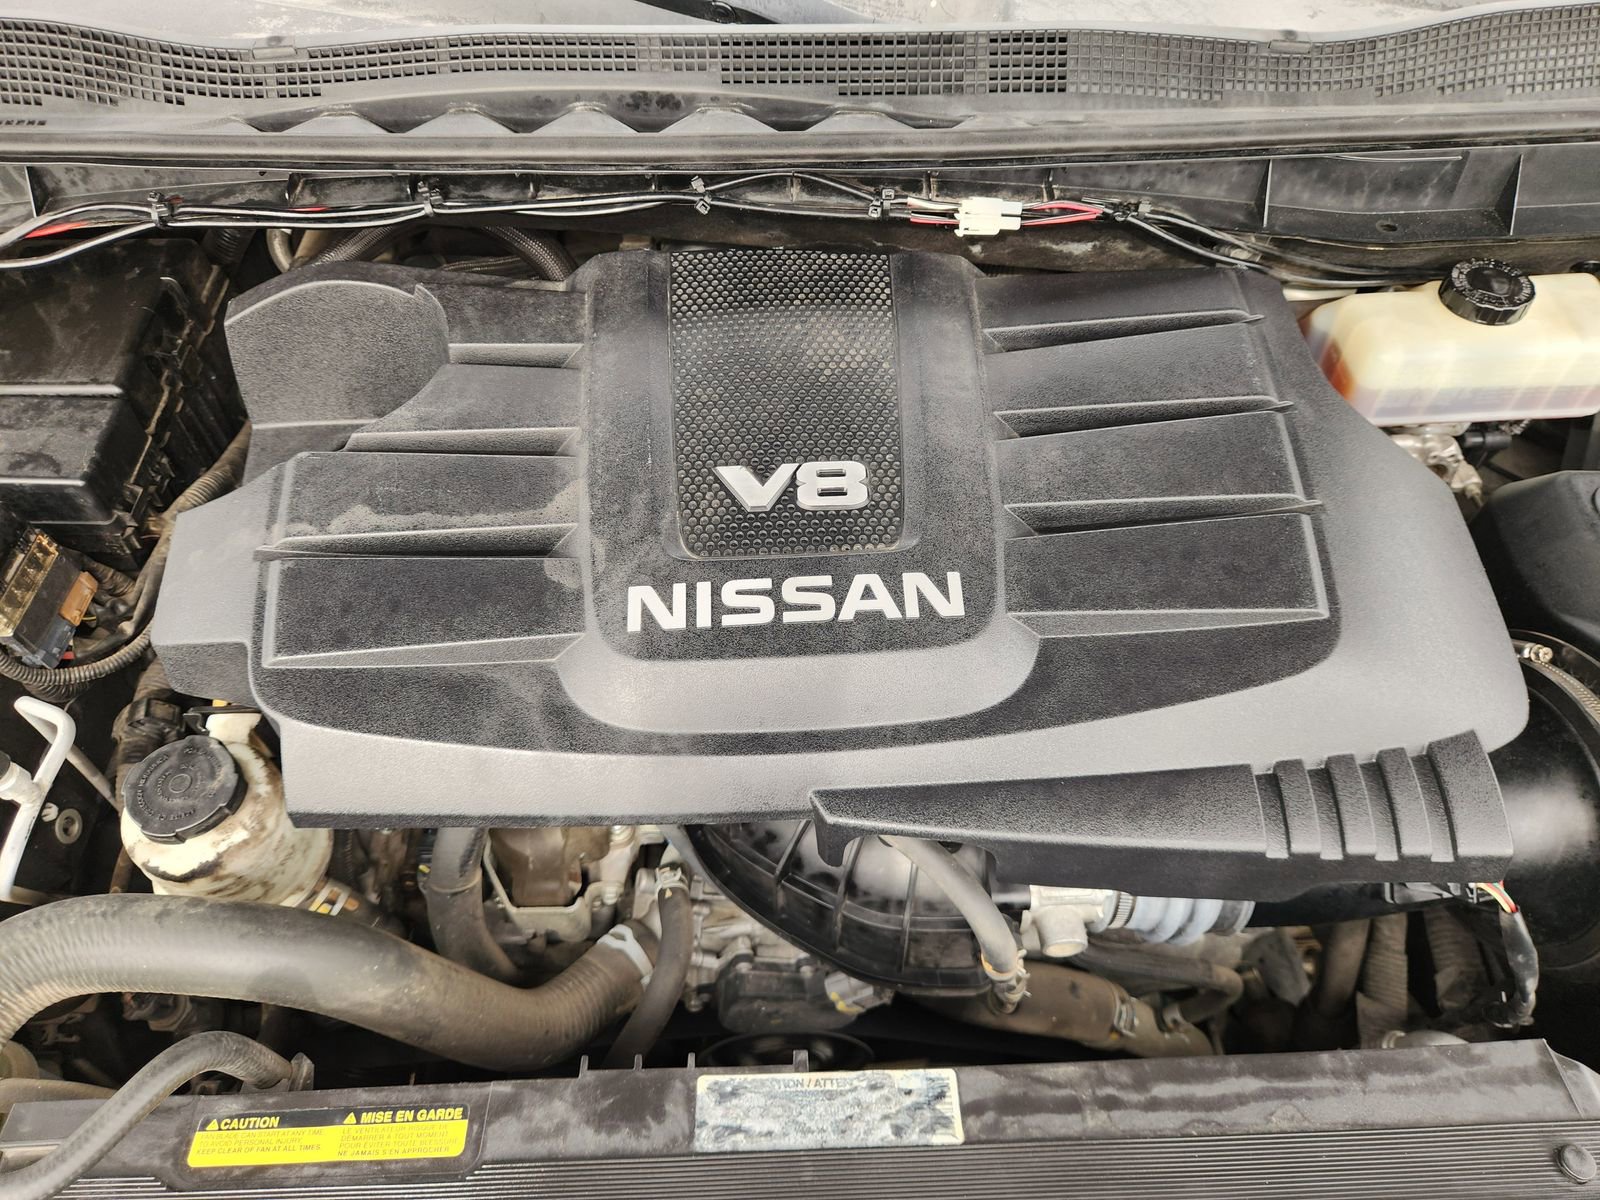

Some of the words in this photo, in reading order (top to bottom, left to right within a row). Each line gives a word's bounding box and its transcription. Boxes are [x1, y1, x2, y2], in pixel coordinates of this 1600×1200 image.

[711, 460, 870, 512] V8
[627, 571, 965, 632] NISSAN
[360, 1110, 394, 1124] MISE
[395, 1109, 415, 1123] EN
[416, 1107, 464, 1121] GARDE
[220, 1116, 280, 1130] CAUTION
[291, 1129, 307, 1137] ANY
[233, 1138, 274, 1147] PERSONAL
[402, 1146, 450, 1154] APPROCHER
